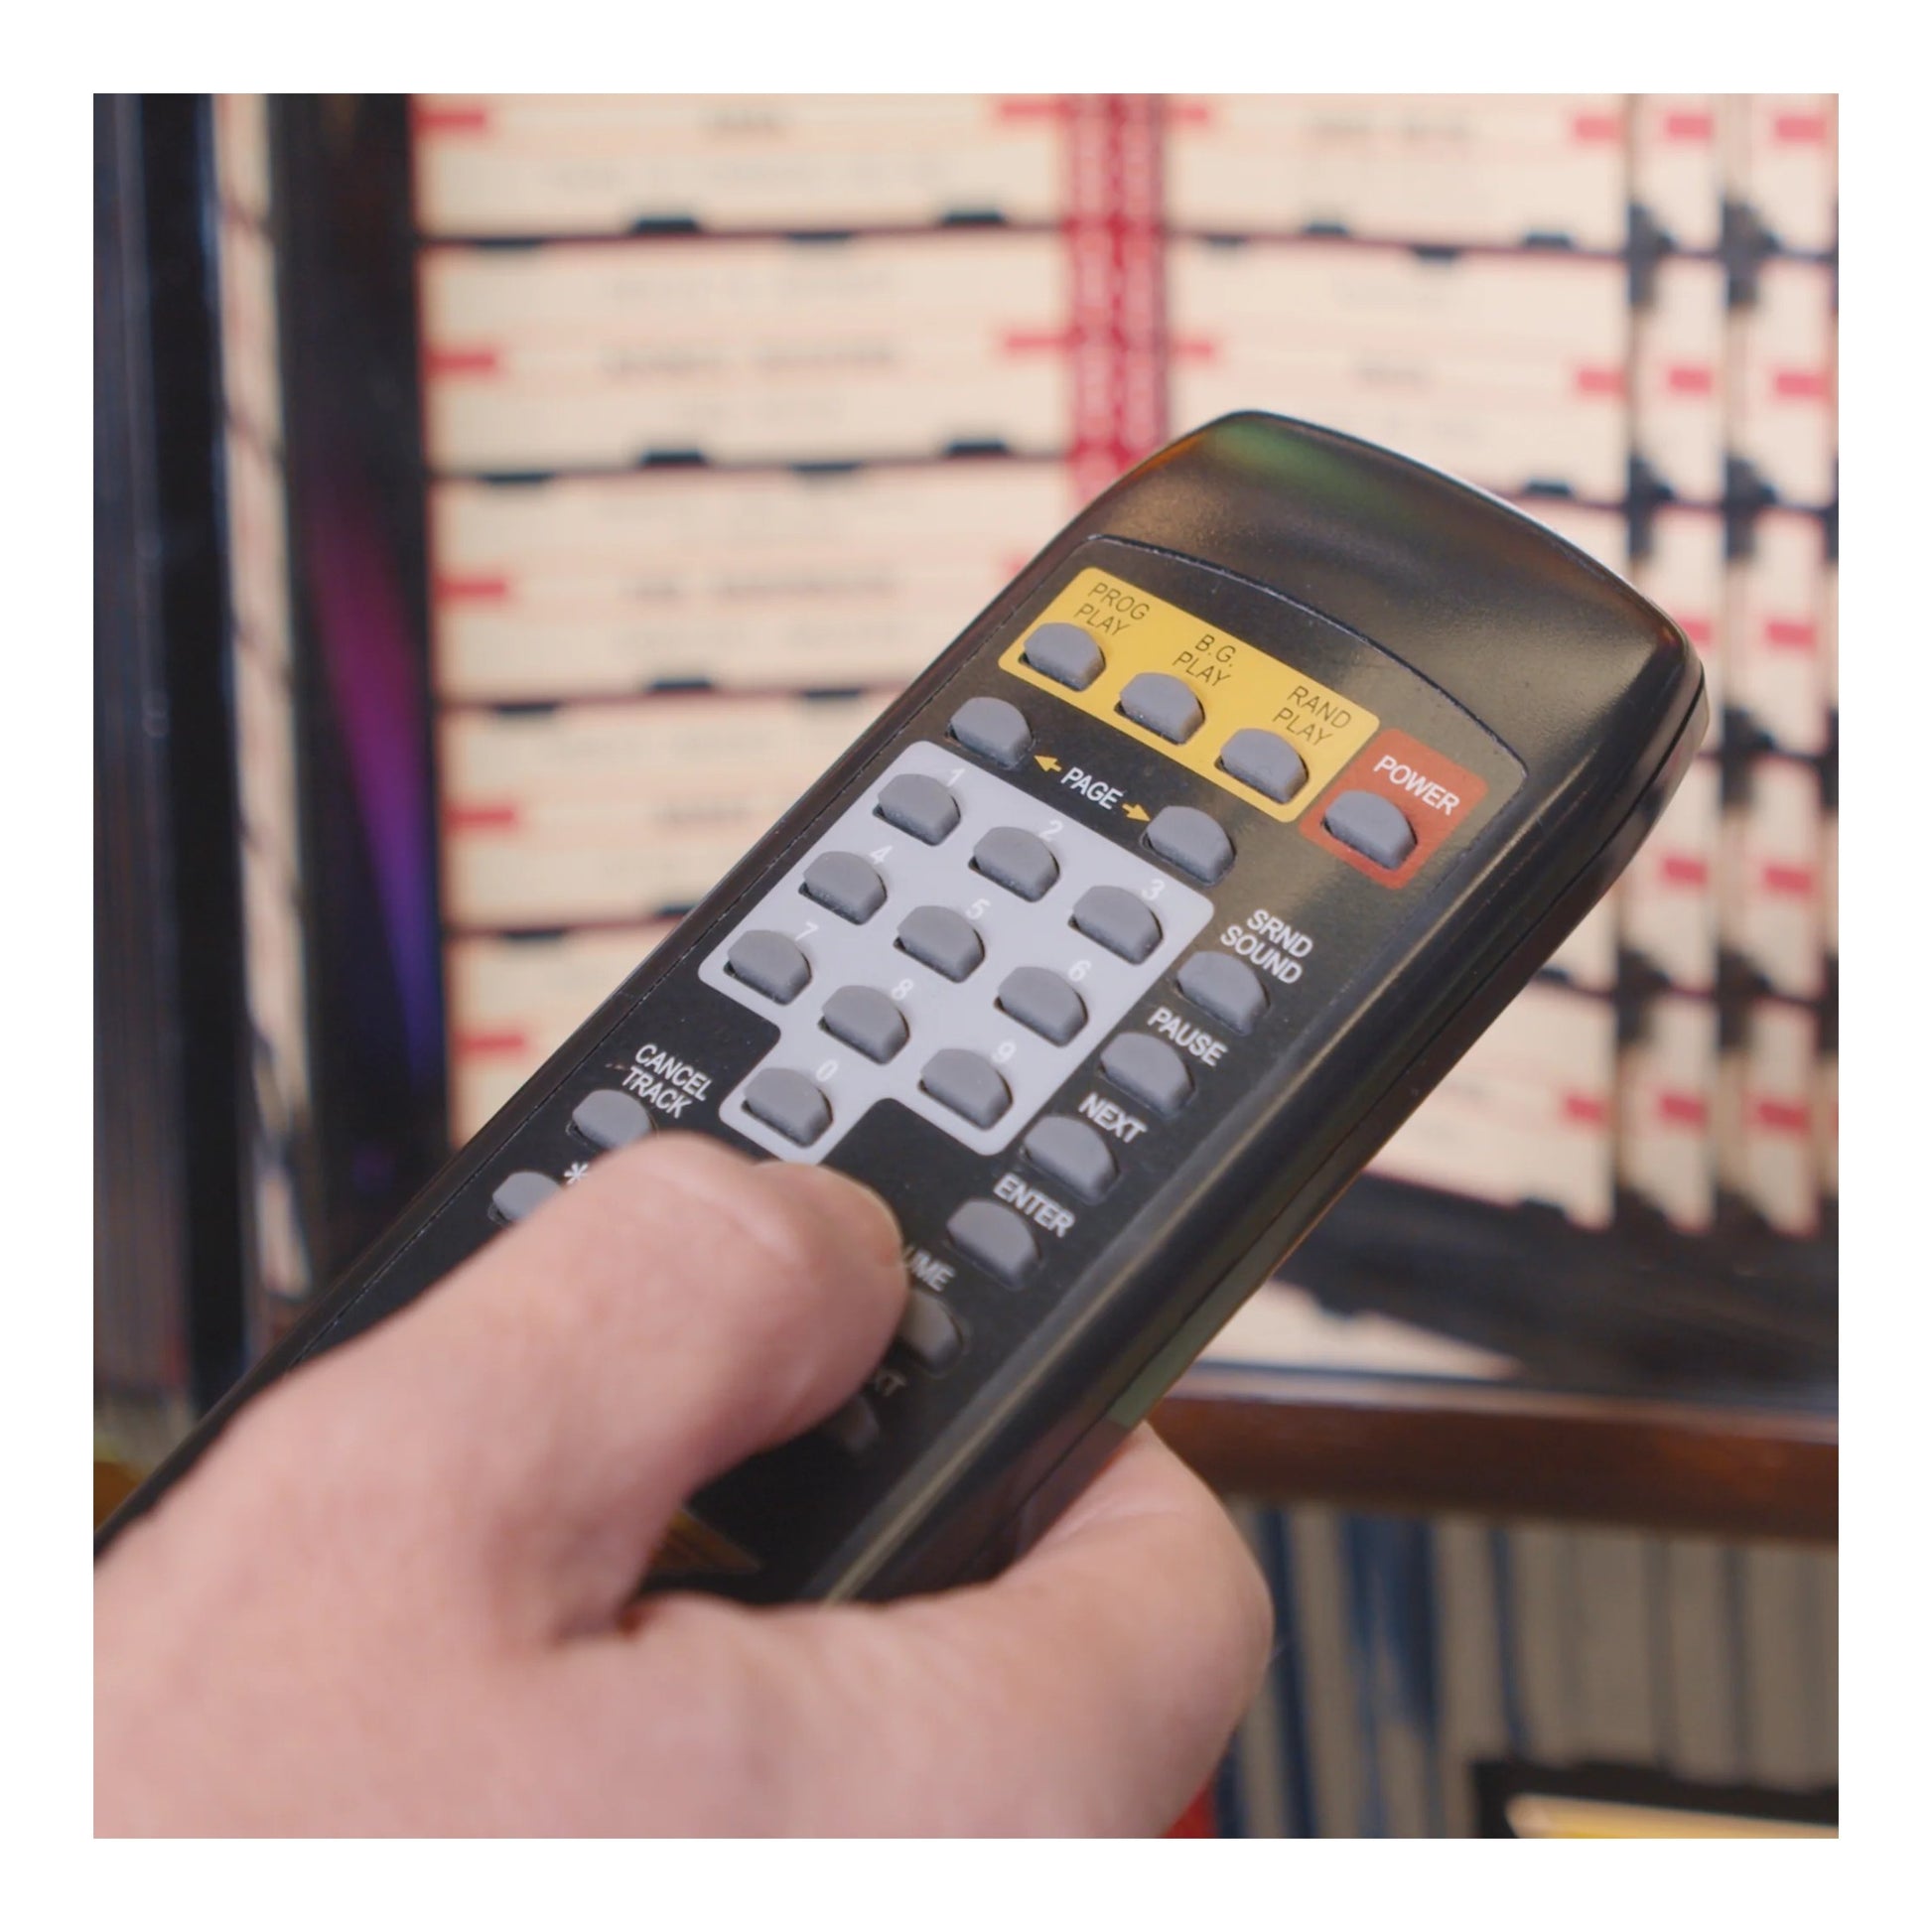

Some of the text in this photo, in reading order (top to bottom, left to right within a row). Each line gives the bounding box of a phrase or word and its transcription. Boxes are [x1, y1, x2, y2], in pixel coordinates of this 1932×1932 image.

[1073, 603, 1132, 636] PLAY
[1087, 582, 1151, 621] PROG
[1194, 634, 1237, 667] B.G.
[1173, 651, 1230, 688] PLAY
[1286, 686, 1351, 730] RAND
[1273, 708, 1333, 748] PLAY
[947, 768, 965, 787] 1
[1061, 767, 1124, 810] PAGE
[1373, 756, 1460, 816] POWER
[1039, 820, 1063, 841] 2
[869, 845, 893, 865] 4
[965, 897, 991, 920] 5
[1143, 879, 1166, 901] 3
[795, 921, 819, 941] 7
[1246, 908, 1313, 958] SRND
[1067, 960, 1091, 982] 6
[1220, 924, 1303, 984] SOUND
[892, 978, 914, 1001] 8
[993, 1040, 1018, 1064] 9
[1147, 1006, 1229, 1067] PAUSE
[634, 1043, 713, 1102] CANCEL
[815, 1059, 839, 1082] 0
[621, 1066, 692, 1119] TRACK
[1078, 1092, 1148, 1144] NEXT
[994, 1173, 1076, 1239] ENTER
